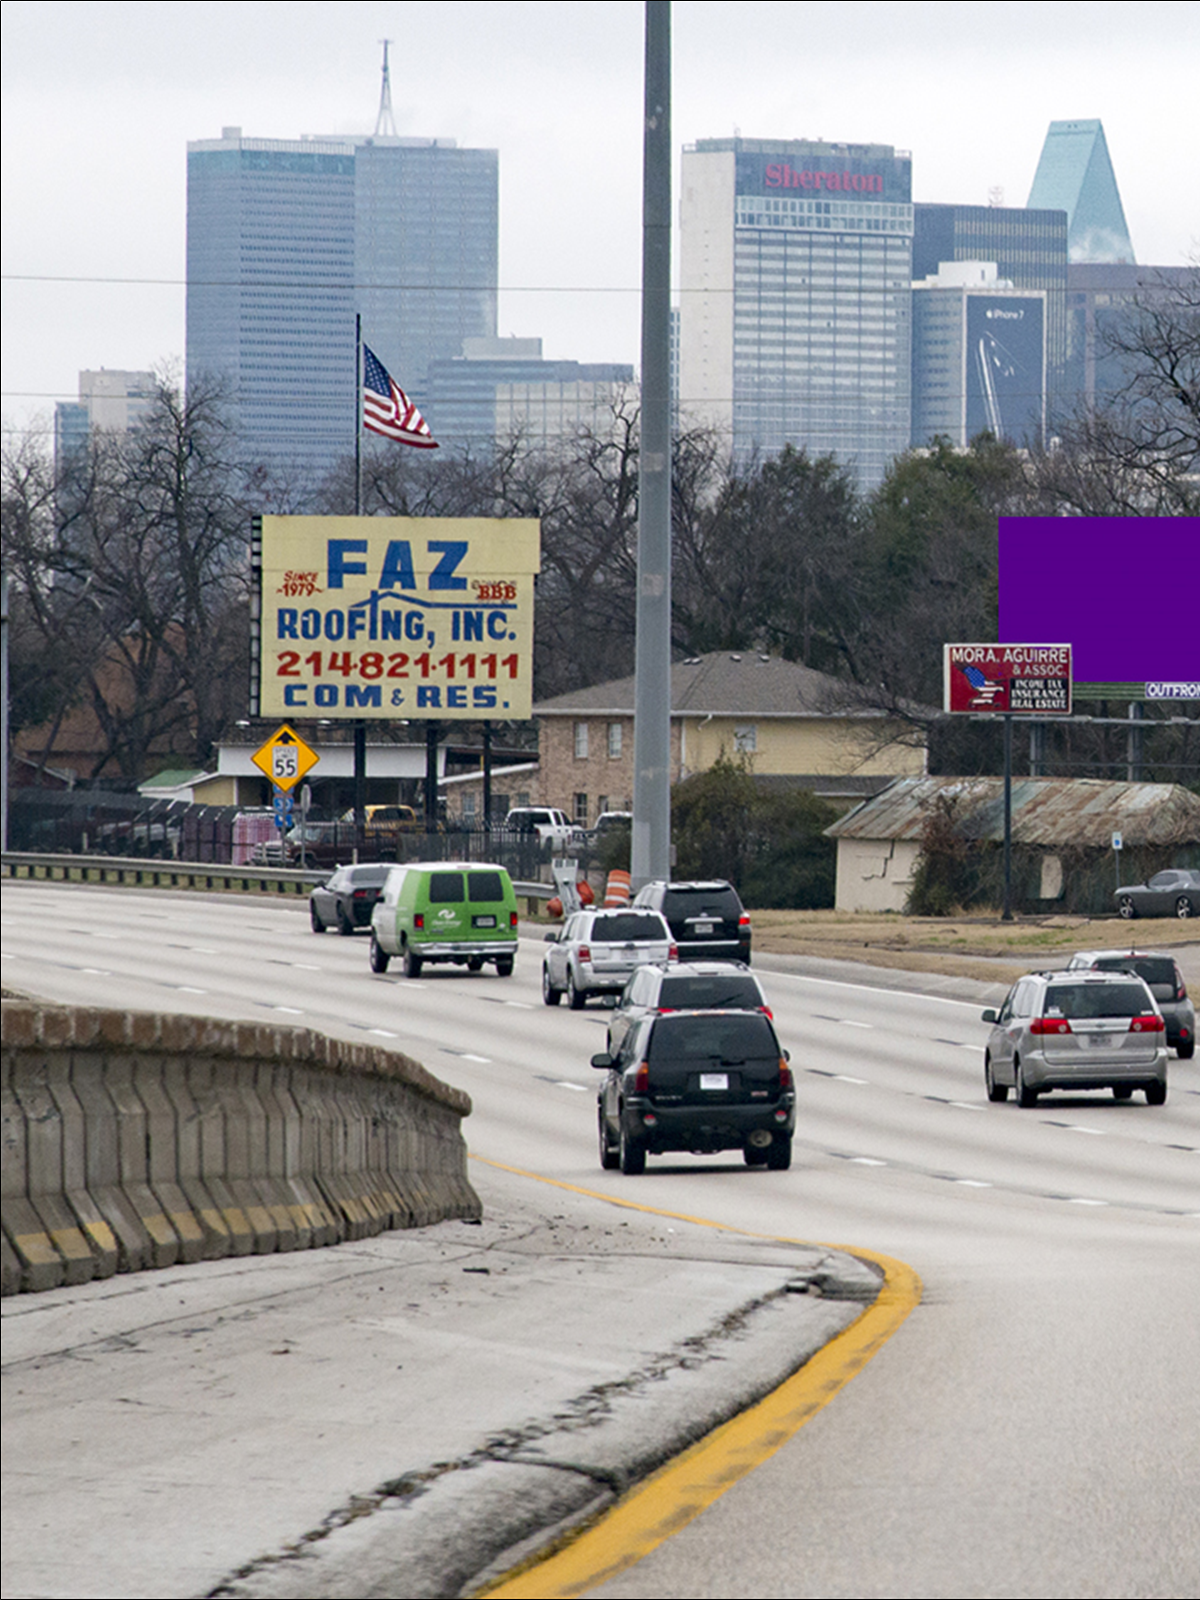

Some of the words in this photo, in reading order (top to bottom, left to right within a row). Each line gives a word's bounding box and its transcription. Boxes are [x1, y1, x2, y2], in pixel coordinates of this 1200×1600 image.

[765, 163, 884, 194] Sheraton
[993, 309, 1018, 320] iPhone
[1019, 309, 1025, 320] 7
[327, 539, 469, 591] FAZ
[478, 584, 518, 600] BBB
[277, 606, 436, 650] ROOFING,
[451, 610, 517, 642] INC.
[1003, 648, 1068, 664] AGUIRRE
[1012, 665, 1021, 676] &
[1014, 679, 1045, 689] INCOME
[1047, 679, 1063, 689] TAX
[283, 683, 382, 708] COM
[390, 687, 405, 707] &
[416, 684, 511, 709] RES.
[1011, 689, 1067, 699] INSURANCE
[1011, 699, 1034, 709] REAL
[1034, 699, 1067, 709] ESTATE
[275, 759, 296, 777] 55
